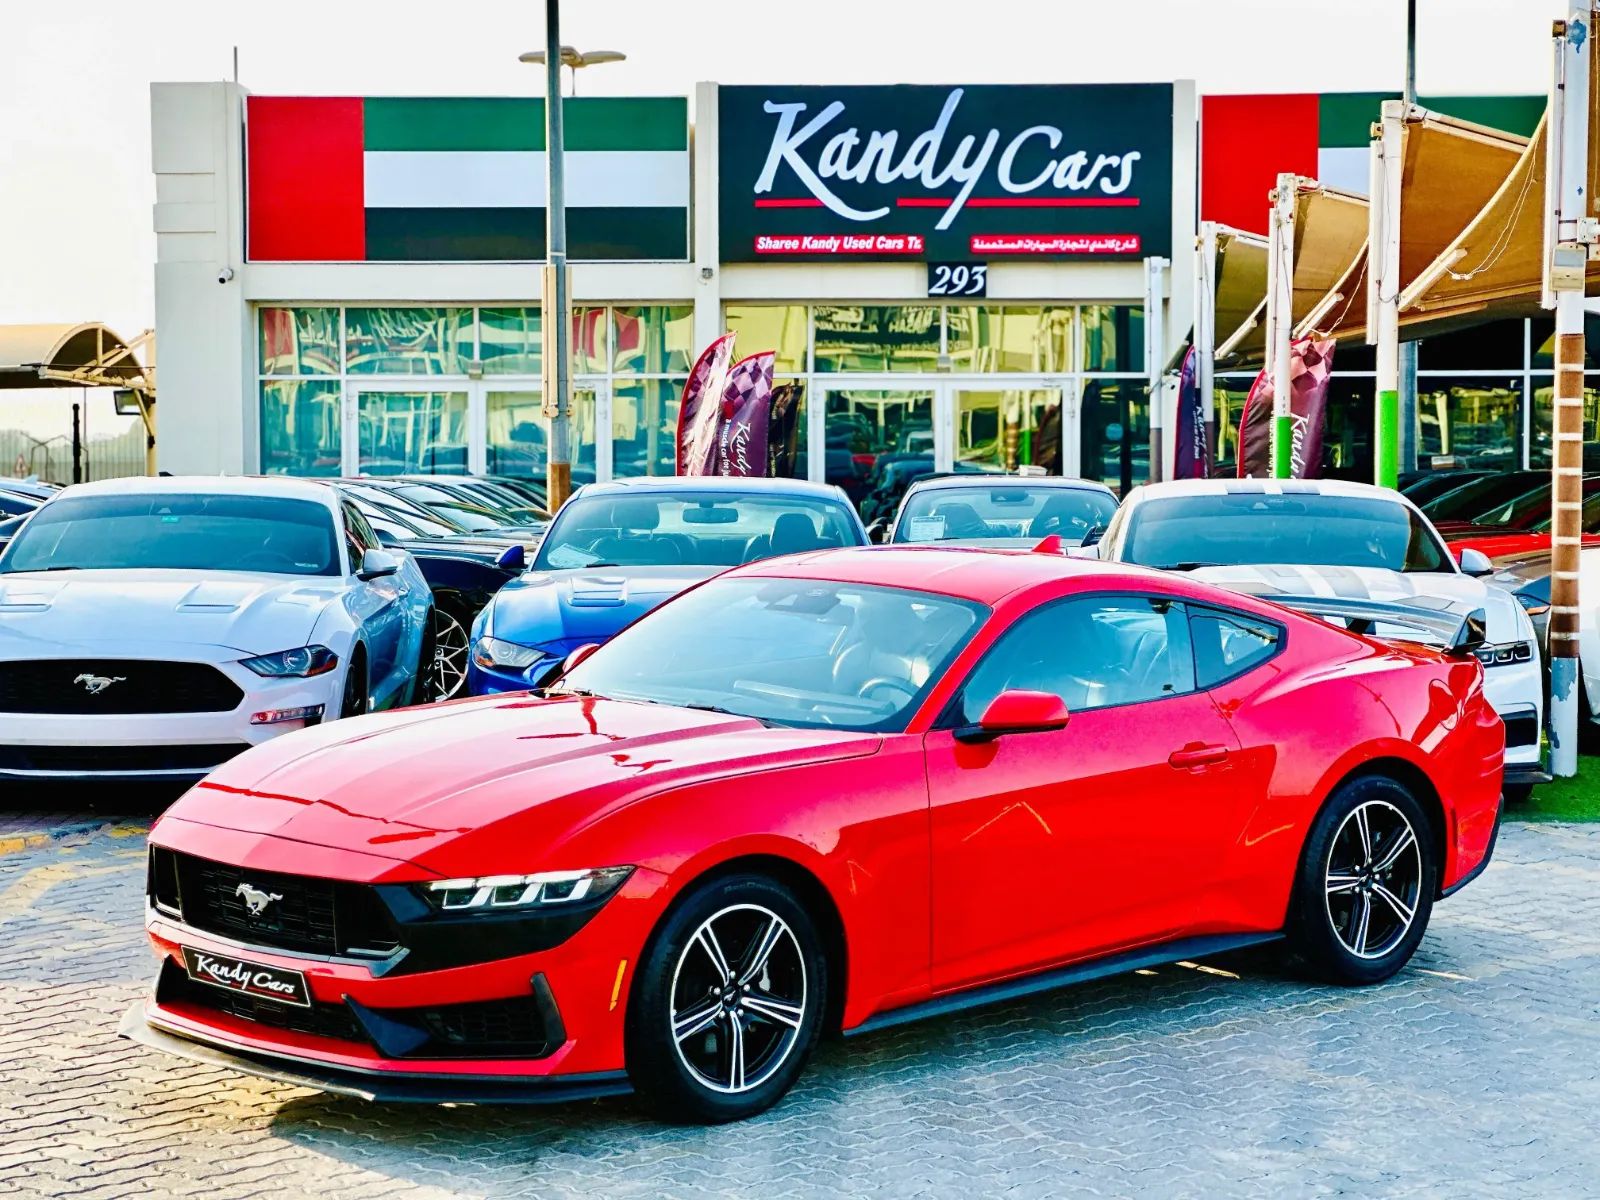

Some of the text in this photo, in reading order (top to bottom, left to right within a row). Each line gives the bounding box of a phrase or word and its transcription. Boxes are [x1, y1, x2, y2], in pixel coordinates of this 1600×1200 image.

[753, 88, 1141, 230] Kandy Cars
[756, 236, 800, 251] Sharee
[801, 236, 841, 253] Kandy
[842, 236, 875, 250] Used
[876, 236, 905, 250] Cars
[928, 265, 988, 295] 293
[729, 421, 752, 475] Kandy
[193, 953, 296, 994] Kandy Cars
